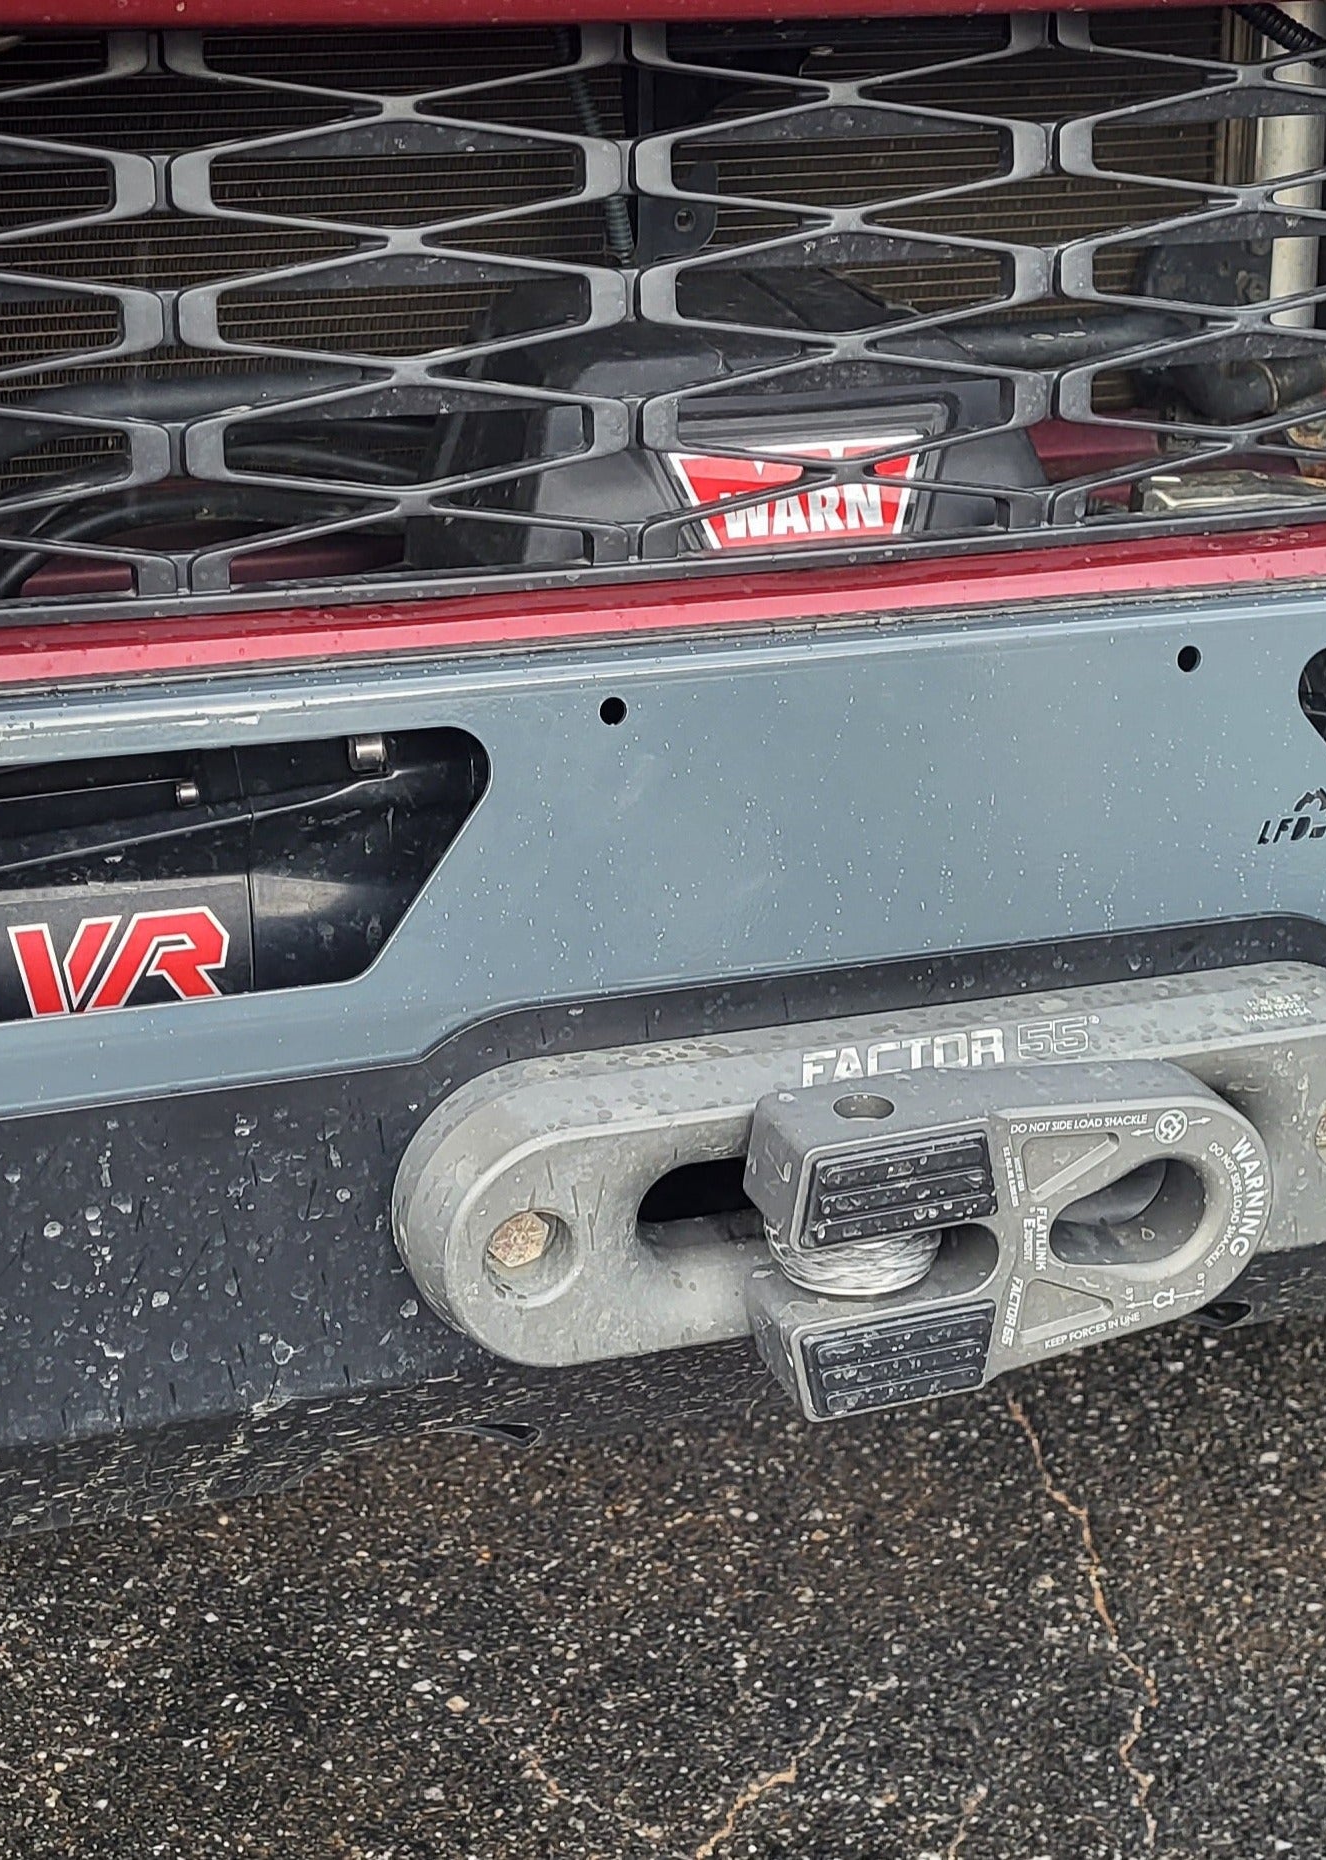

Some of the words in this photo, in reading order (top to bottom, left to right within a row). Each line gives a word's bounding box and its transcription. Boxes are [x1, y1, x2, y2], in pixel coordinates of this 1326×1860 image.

[719, 484, 884, 540] WARN
[7, 905, 230, 1017] VR
[802, 1028, 1005, 1088] FACTOR
[1017, 1015, 1090, 1060] 55
[1010, 1123, 1026, 1135] DO
[1029, 1121, 1051, 1133] NOT
[1052, 1119, 1073, 1132] SIDE
[1074, 1117, 1103, 1130] LOAD
[1104, 1114, 1149, 1128] SHACKLE
[1208, 1142, 1224, 1157] DO
[1221, 1153, 1238, 1174] NOT
[1230, 1172, 1243, 1195] SIDE
[1230, 1136, 1265, 1258] WARNING
[1230, 1194, 1243, 1225] LOAD
[1203, 1224, 1237, 1269] SHACKLE
[1005, 1275, 1024, 1328] FACTOR
[1044, 1334, 1068, 1349] KEEP
[1069, 1322, 1107, 1342] FORCES
[1107, 1318, 1121, 1331] IN
[1120, 1311, 1142, 1327] LINE
